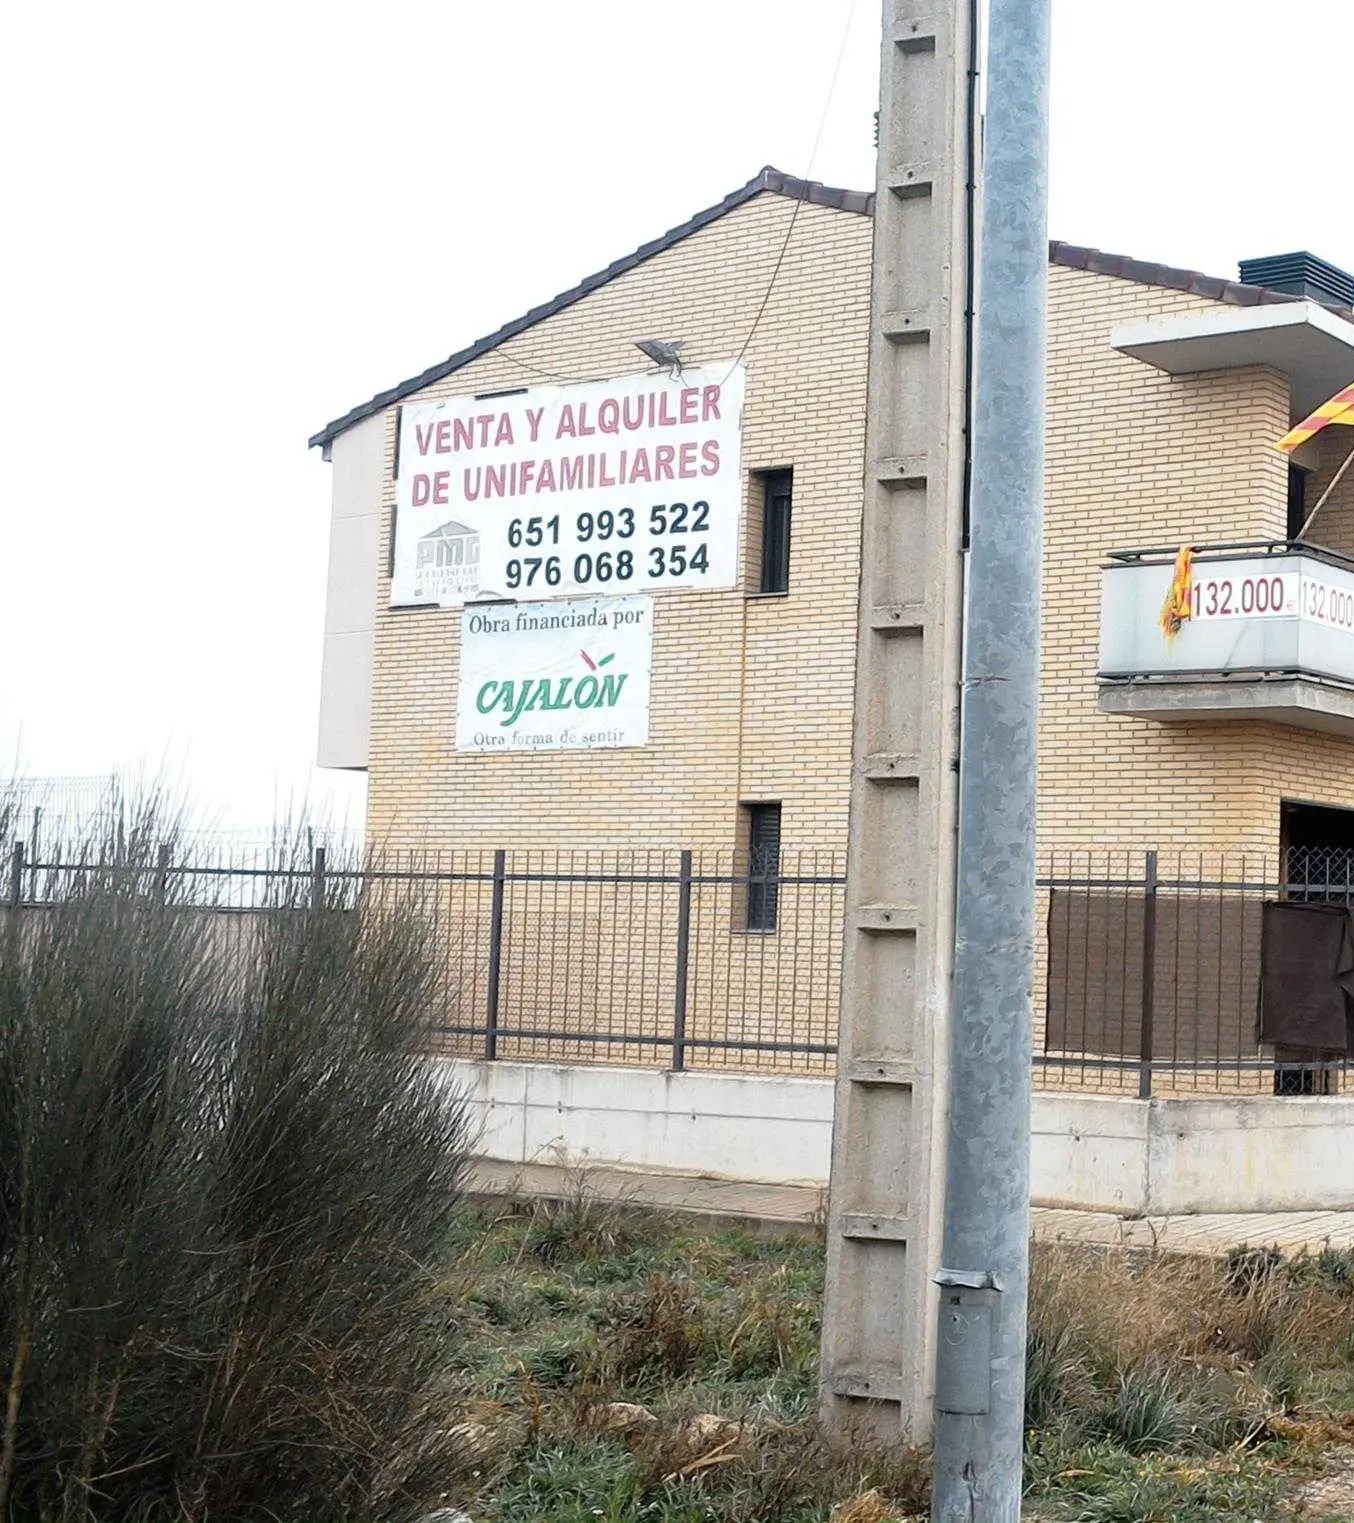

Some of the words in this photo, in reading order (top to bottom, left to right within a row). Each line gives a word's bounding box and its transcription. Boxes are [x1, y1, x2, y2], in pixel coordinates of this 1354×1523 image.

[416, 411, 514, 456] VENTA
[525, 406, 545, 442] Y
[555, 384, 722, 440] ALQUILER
[411, 470, 450, 507] DE
[464, 439, 721, 501] UNIFAMILIARES
[507, 514, 560, 548] 651
[576, 507, 636, 542] 993
[649, 500, 710, 536] 522
[505, 556, 562, 589] 976
[573, 550, 634, 584] 068
[648, 543, 709, 578] 354
[1194, 577, 1284, 617] 132.000
[1303, 581, 1354, 628] 132.000
[469, 615, 511, 634] Obra
[515, 608, 609, 631] financiada
[613, 610, 644, 629] por
[473, 732, 506, 746] Otra
[512, 730, 554, 745] forma
[560, 728, 577, 744] de
[582, 728, 625, 743] sentir
